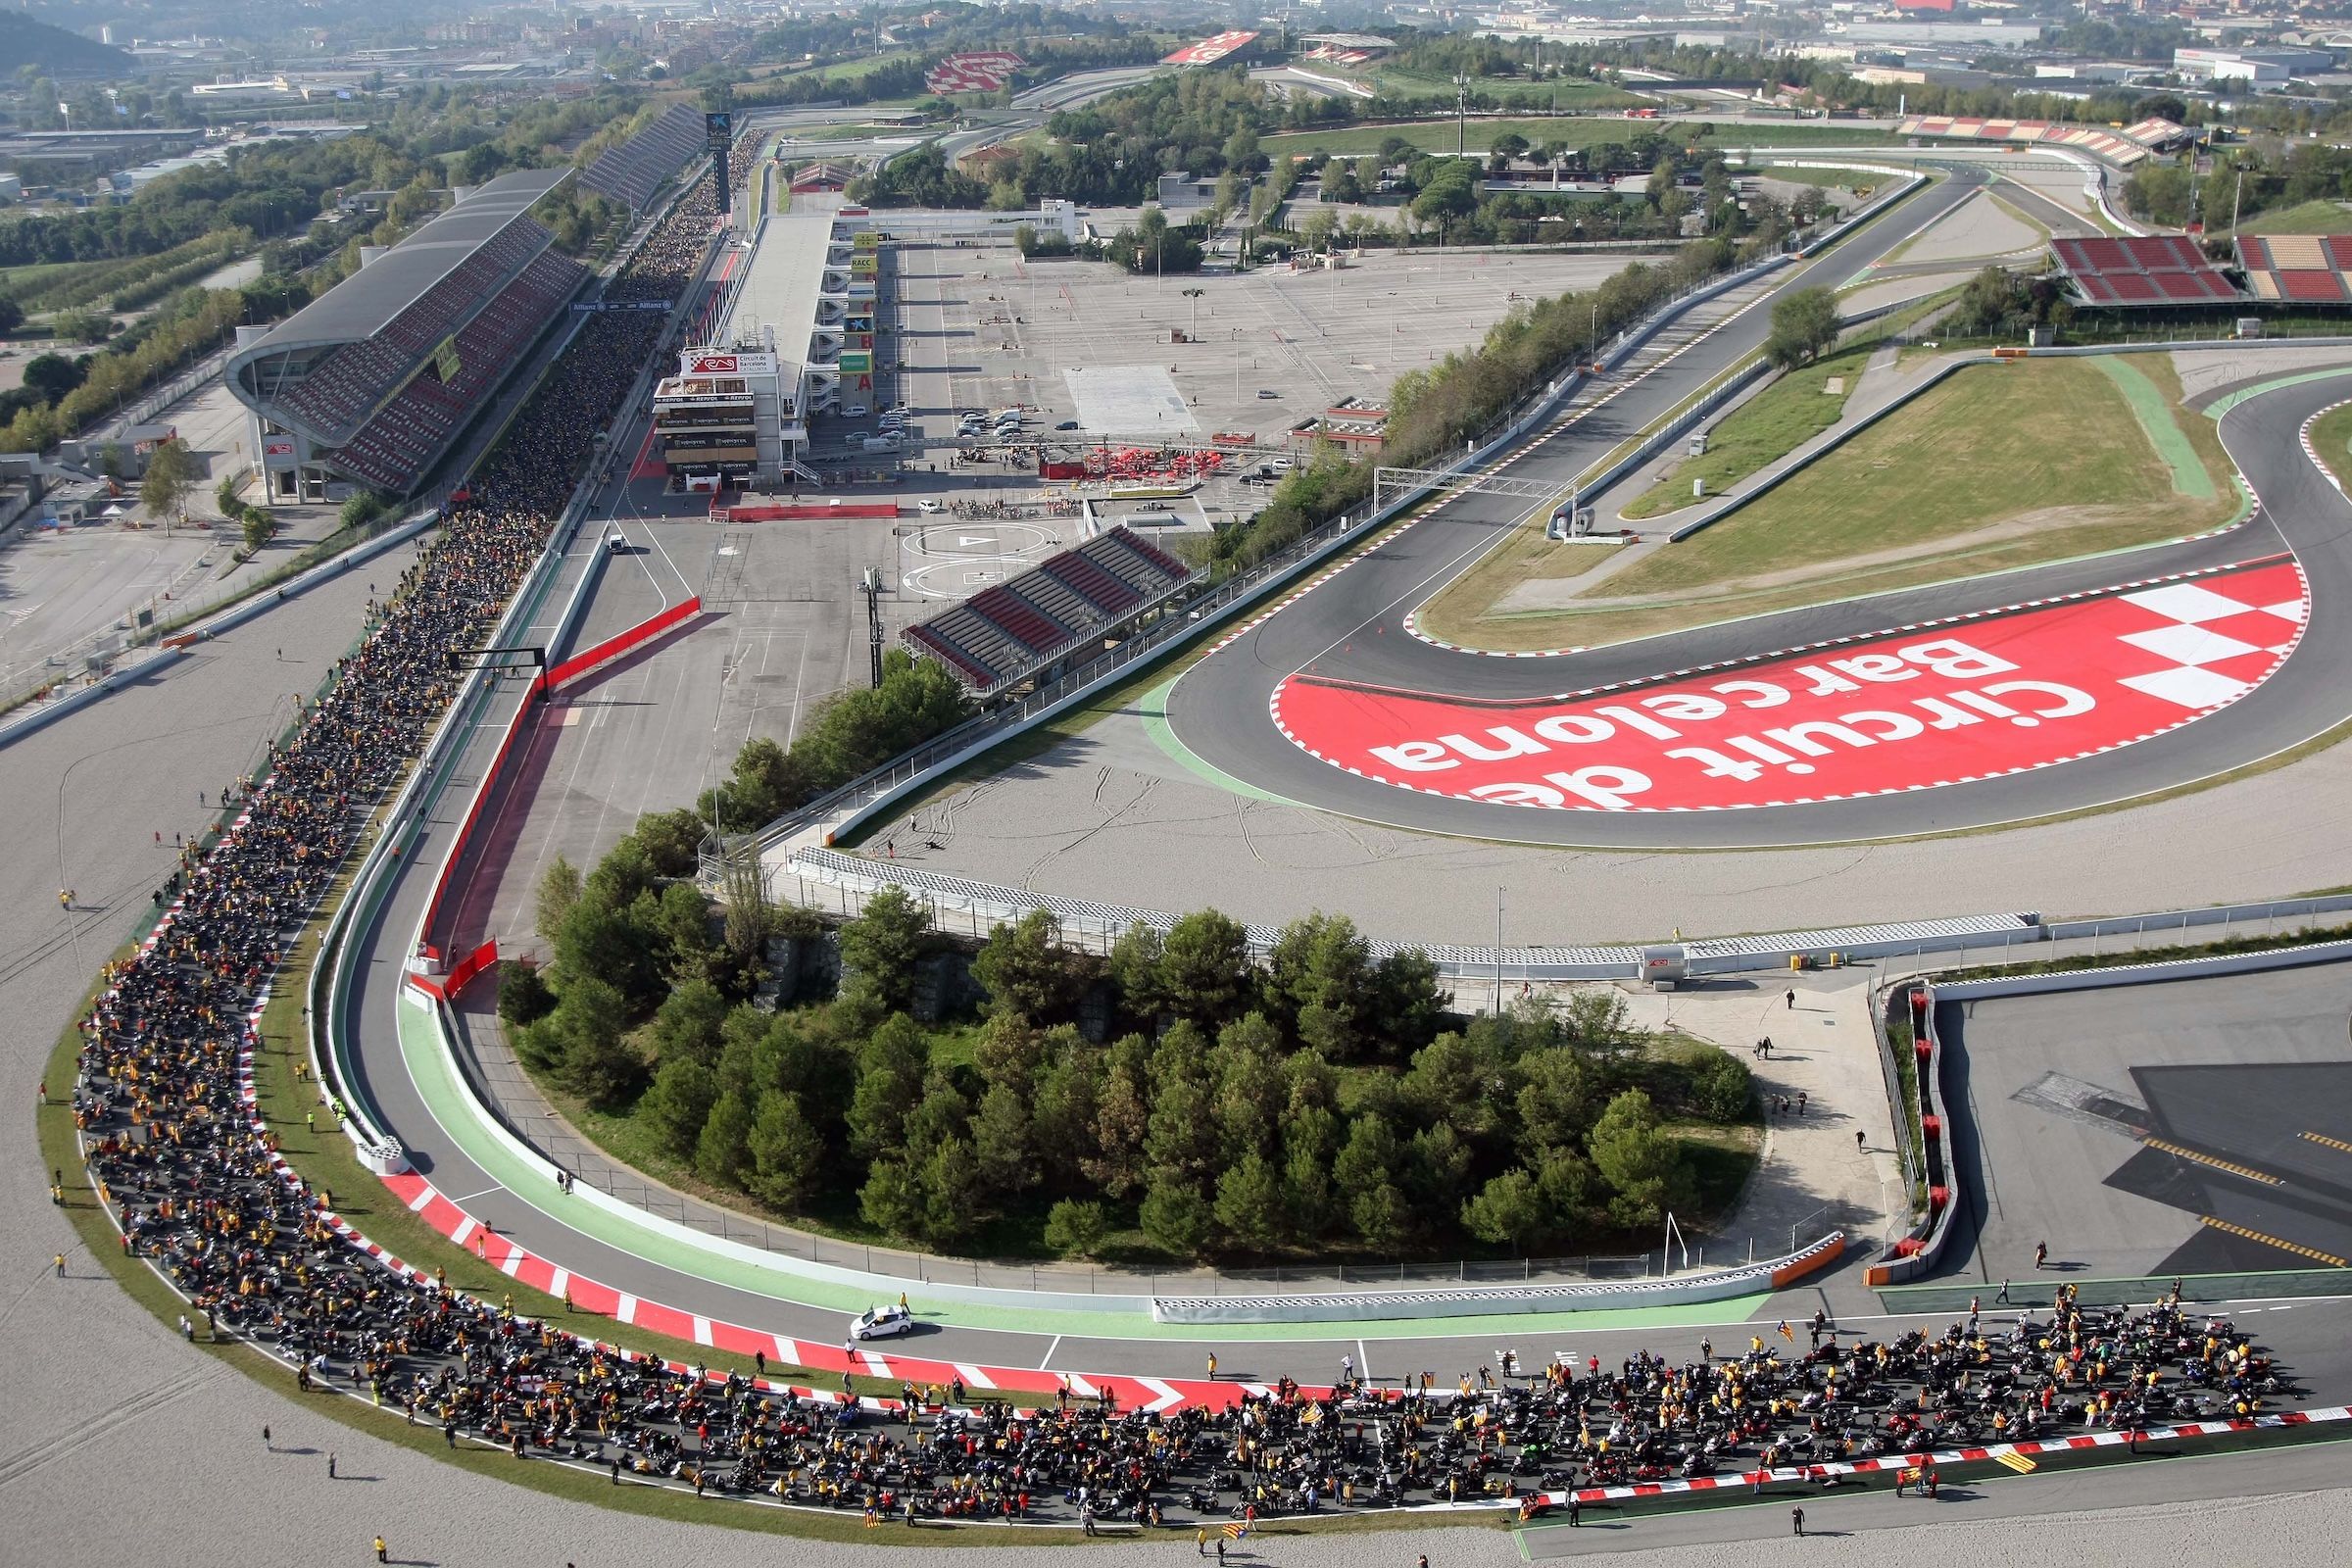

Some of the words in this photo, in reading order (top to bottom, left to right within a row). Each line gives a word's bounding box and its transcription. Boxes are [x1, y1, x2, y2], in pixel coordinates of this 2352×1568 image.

[858, 374, 872, 391] A
[1366, 639, 2023, 772] Barcelona
[1662, 680, 2096, 783] Circuit
[1468, 765, 1653, 808] de
[1554, 1350, 1580, 1365] PIT
